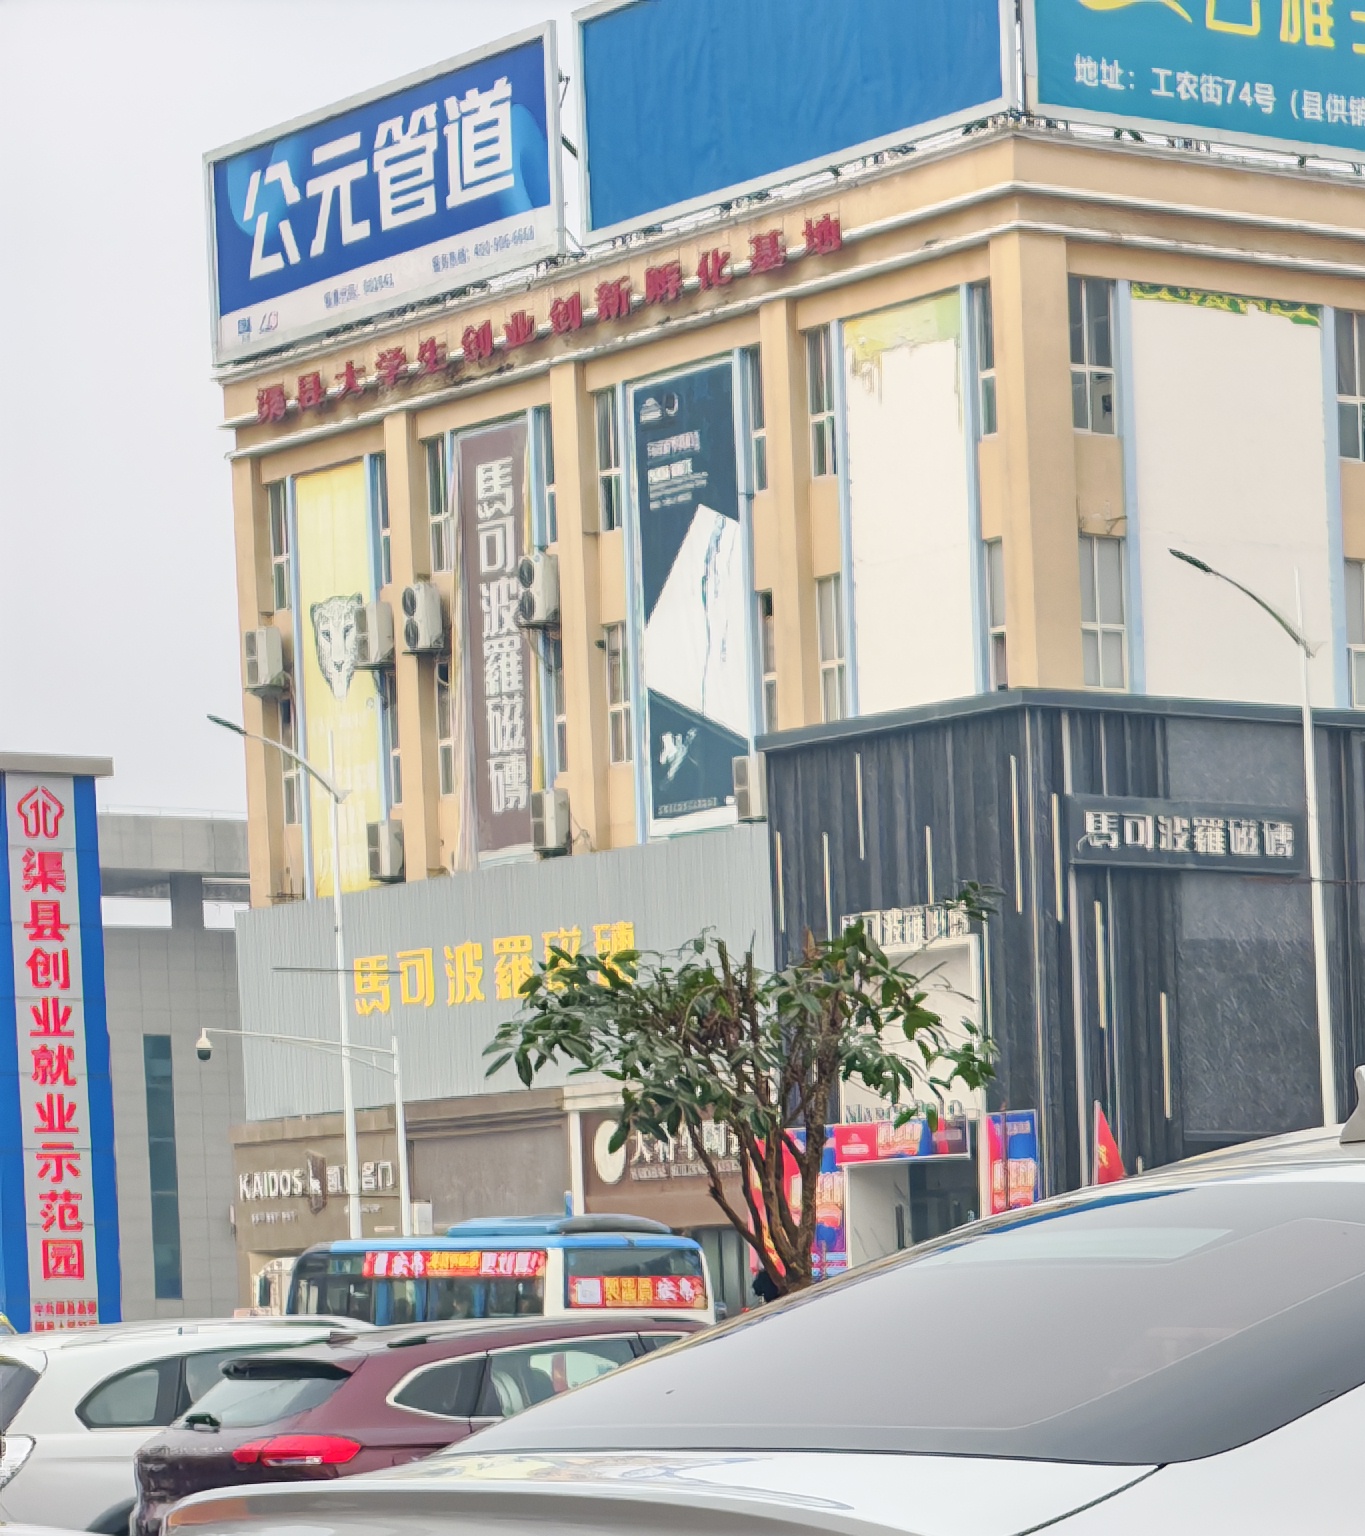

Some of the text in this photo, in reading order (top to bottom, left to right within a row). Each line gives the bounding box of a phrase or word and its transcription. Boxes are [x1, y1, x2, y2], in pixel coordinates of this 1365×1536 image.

[243, 75, 515, 281] 公元管道
[22, 846, 86, 1282] 渠县创业就业示范园
[239, 1167, 304, 1201] KAIDOS
